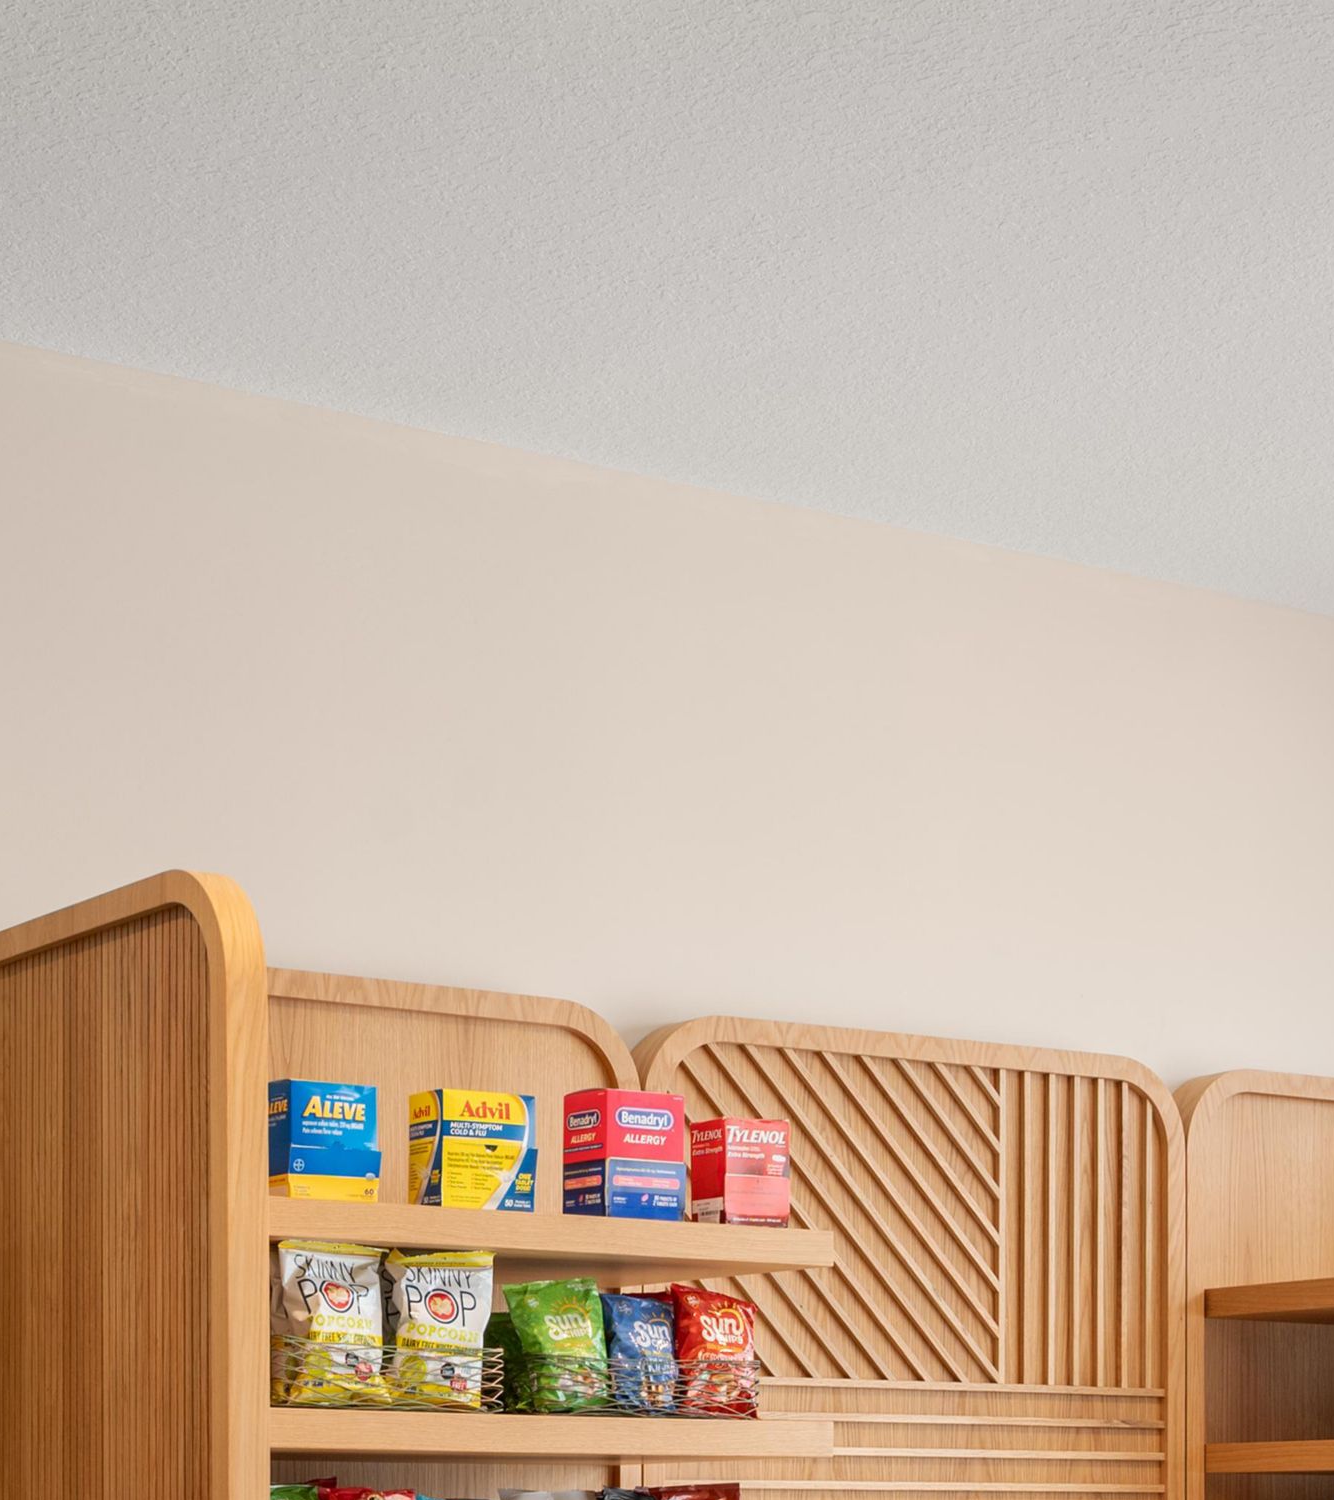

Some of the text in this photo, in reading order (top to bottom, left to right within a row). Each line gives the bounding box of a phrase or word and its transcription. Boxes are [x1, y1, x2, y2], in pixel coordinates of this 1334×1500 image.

[268, 1098, 288, 1116] LEVE
[302, 1094, 366, 1122] ALEVE
[459, 1100, 511, 1121] Advil
[449, 1120, 503, 1132] MULTI-SYMPTOM
[569, 1112, 597, 1127] Benadryl
[621, 1110, 668, 1129] Benadryl
[449, 1128, 468, 1136] COLD
[475, 1129, 487, 1137] FLU
[570, 1132, 597, 1144] ALLERGY
[623, 1133, 667, 1146] ALLERGY
[691, 1129, 722, 1144] TYLENOL
[726, 1125, 786, 1145] TYLENOL
[364, 1188, 375, 1197] 60
[294, 1253, 356, 1284] SKINNY
[297, 1278, 369, 1315] POP
[405, 1284, 477, 1328] POP
